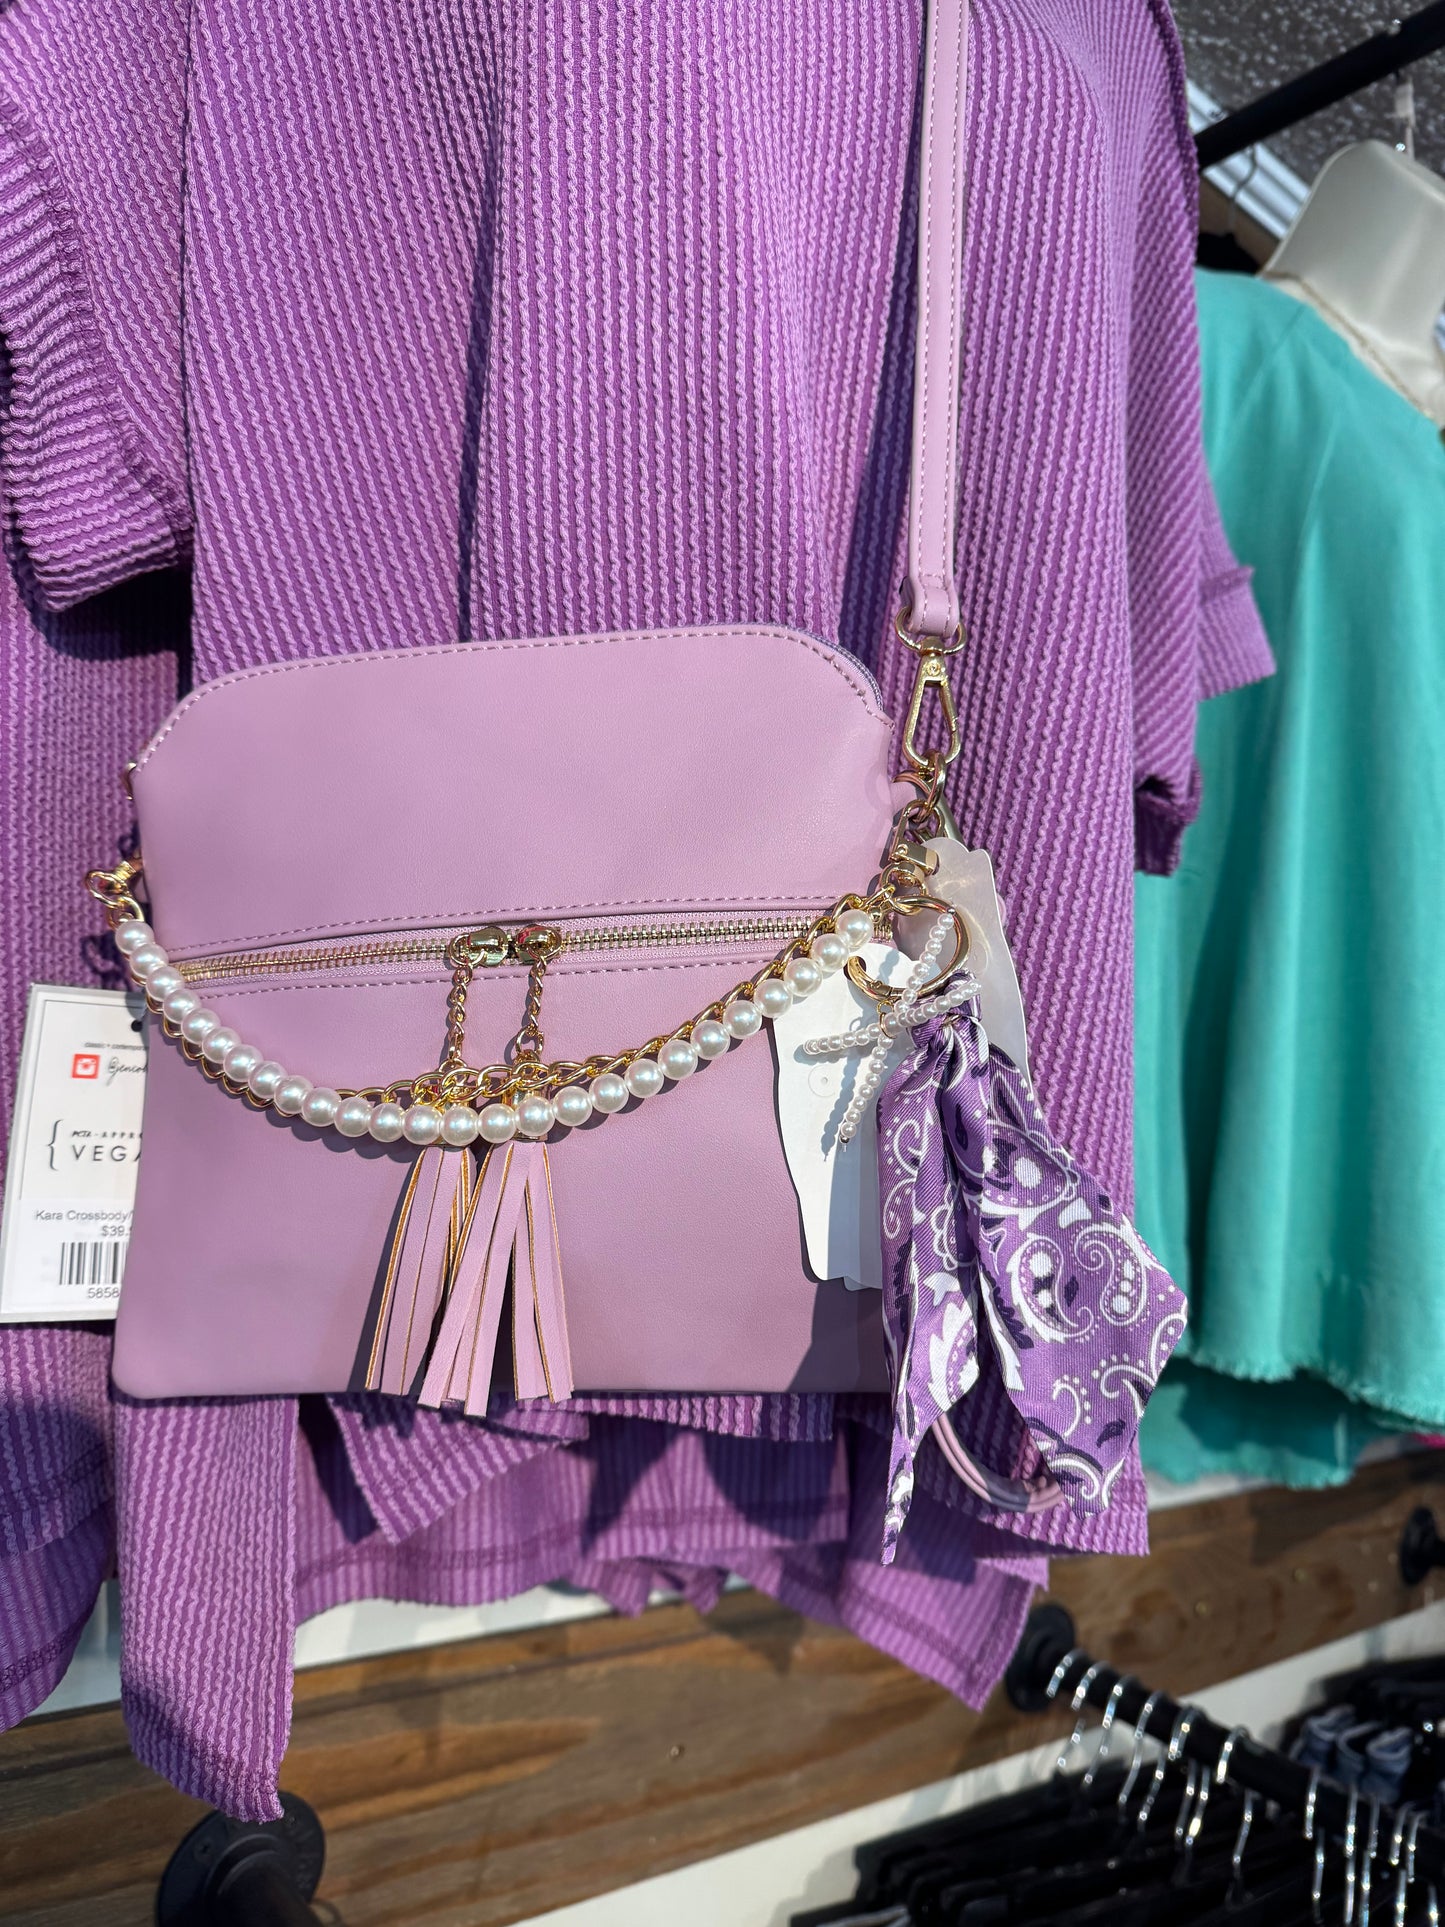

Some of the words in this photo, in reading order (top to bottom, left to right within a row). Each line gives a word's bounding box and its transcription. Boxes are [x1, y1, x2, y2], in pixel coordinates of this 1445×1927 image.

[36, 1209, 63, 1221] Kara
[66, 1209, 135, 1223] Crossbody/
[101, 1225, 133, 1237] $39.
